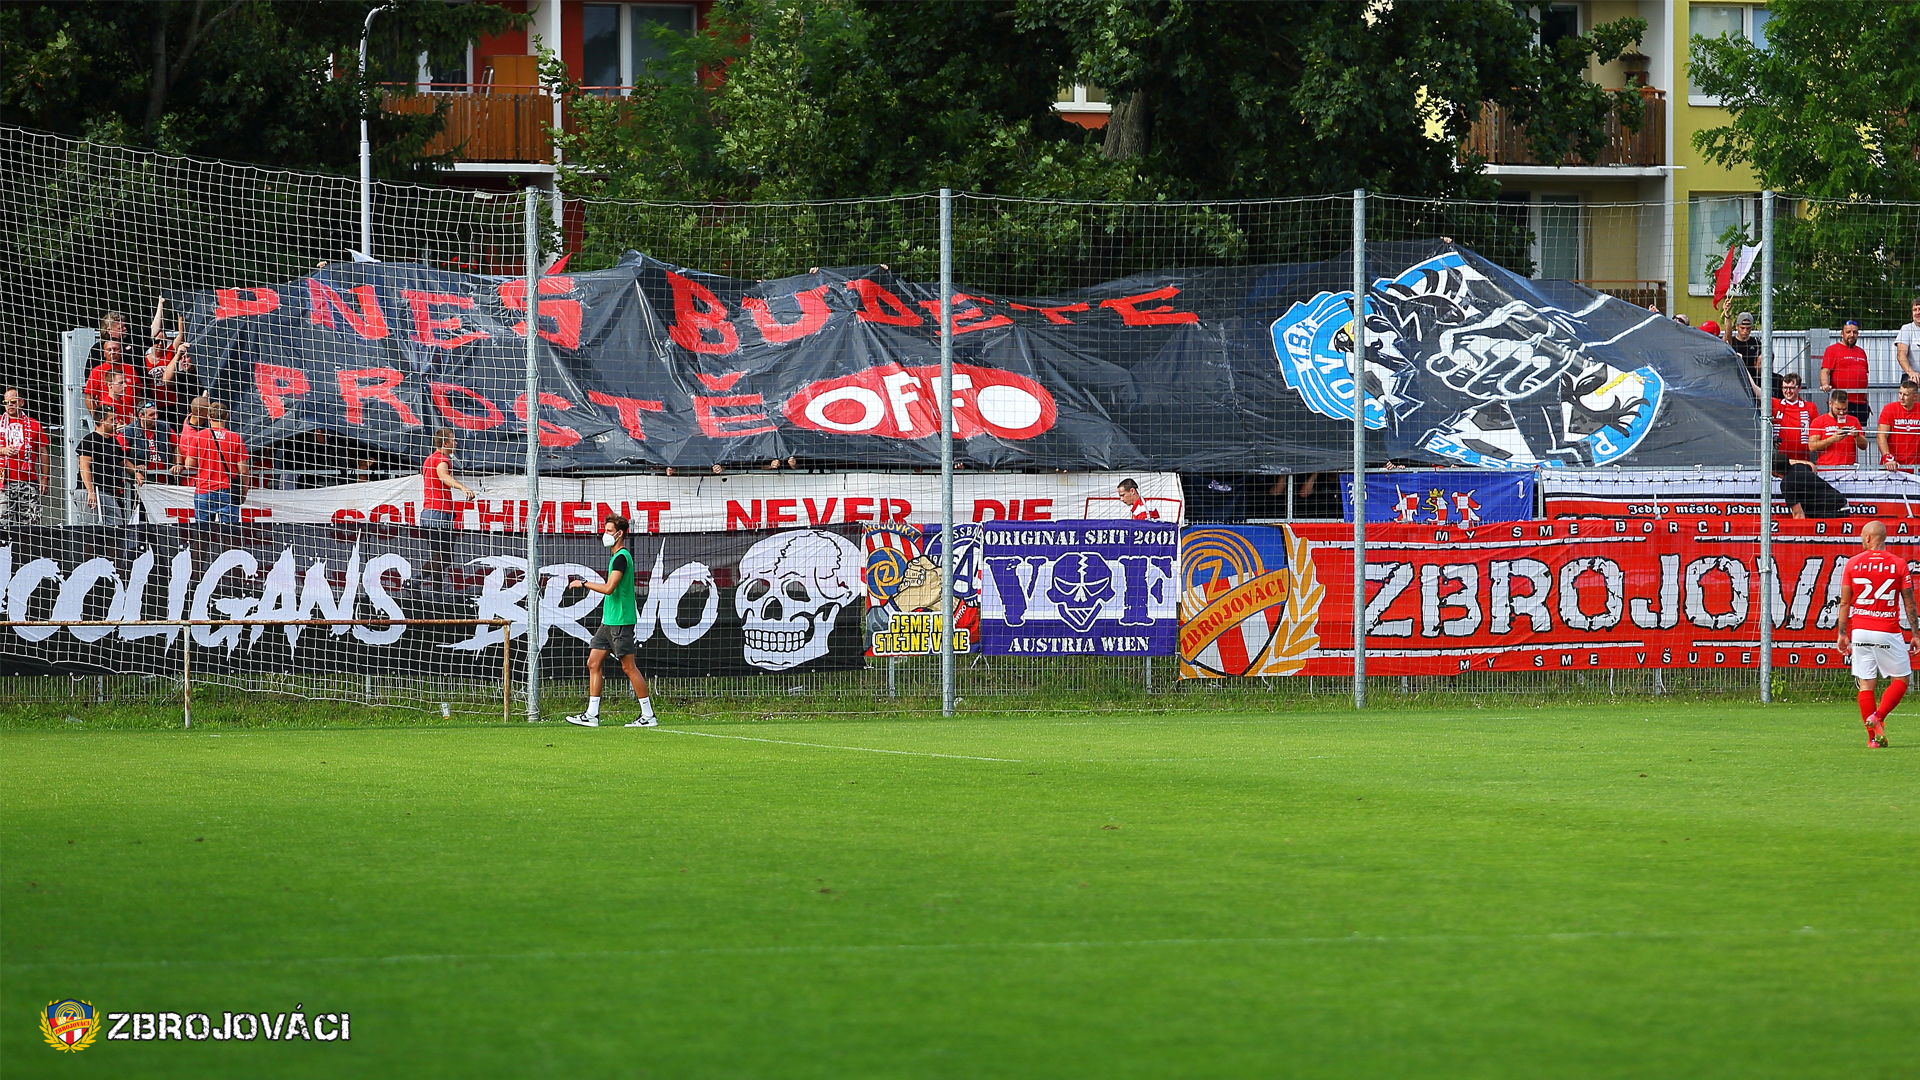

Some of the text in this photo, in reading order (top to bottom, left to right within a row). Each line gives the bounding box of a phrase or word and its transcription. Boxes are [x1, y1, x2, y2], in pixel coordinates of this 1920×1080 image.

[666, 270, 1199, 354] BUDETE
[254, 361, 1042, 448] PROSTĚ OFFO
[727, 498, 912, 530] NEVER
[973, 499, 1053, 522] DIE
[984, 530, 1175, 546] ORIGINAL SEIT 2001
[1435, 521, 1908, 541] MY SME BORCI Z BRA
[984, 555, 1173, 627] V F
[1364, 553, 1920, 639] ZBROJOV
[1853, 577, 1896, 606] 24
[890, 614, 931, 634] JSME
[1180, 578, 1286, 655] ZBROJOVÁCI
[875, 632, 930, 653] STEJNE
[1008, 637, 1150, 652] AUSTRIA WIEN
[1459, 648, 1852, 671] MY SME VŠUDE DOM
